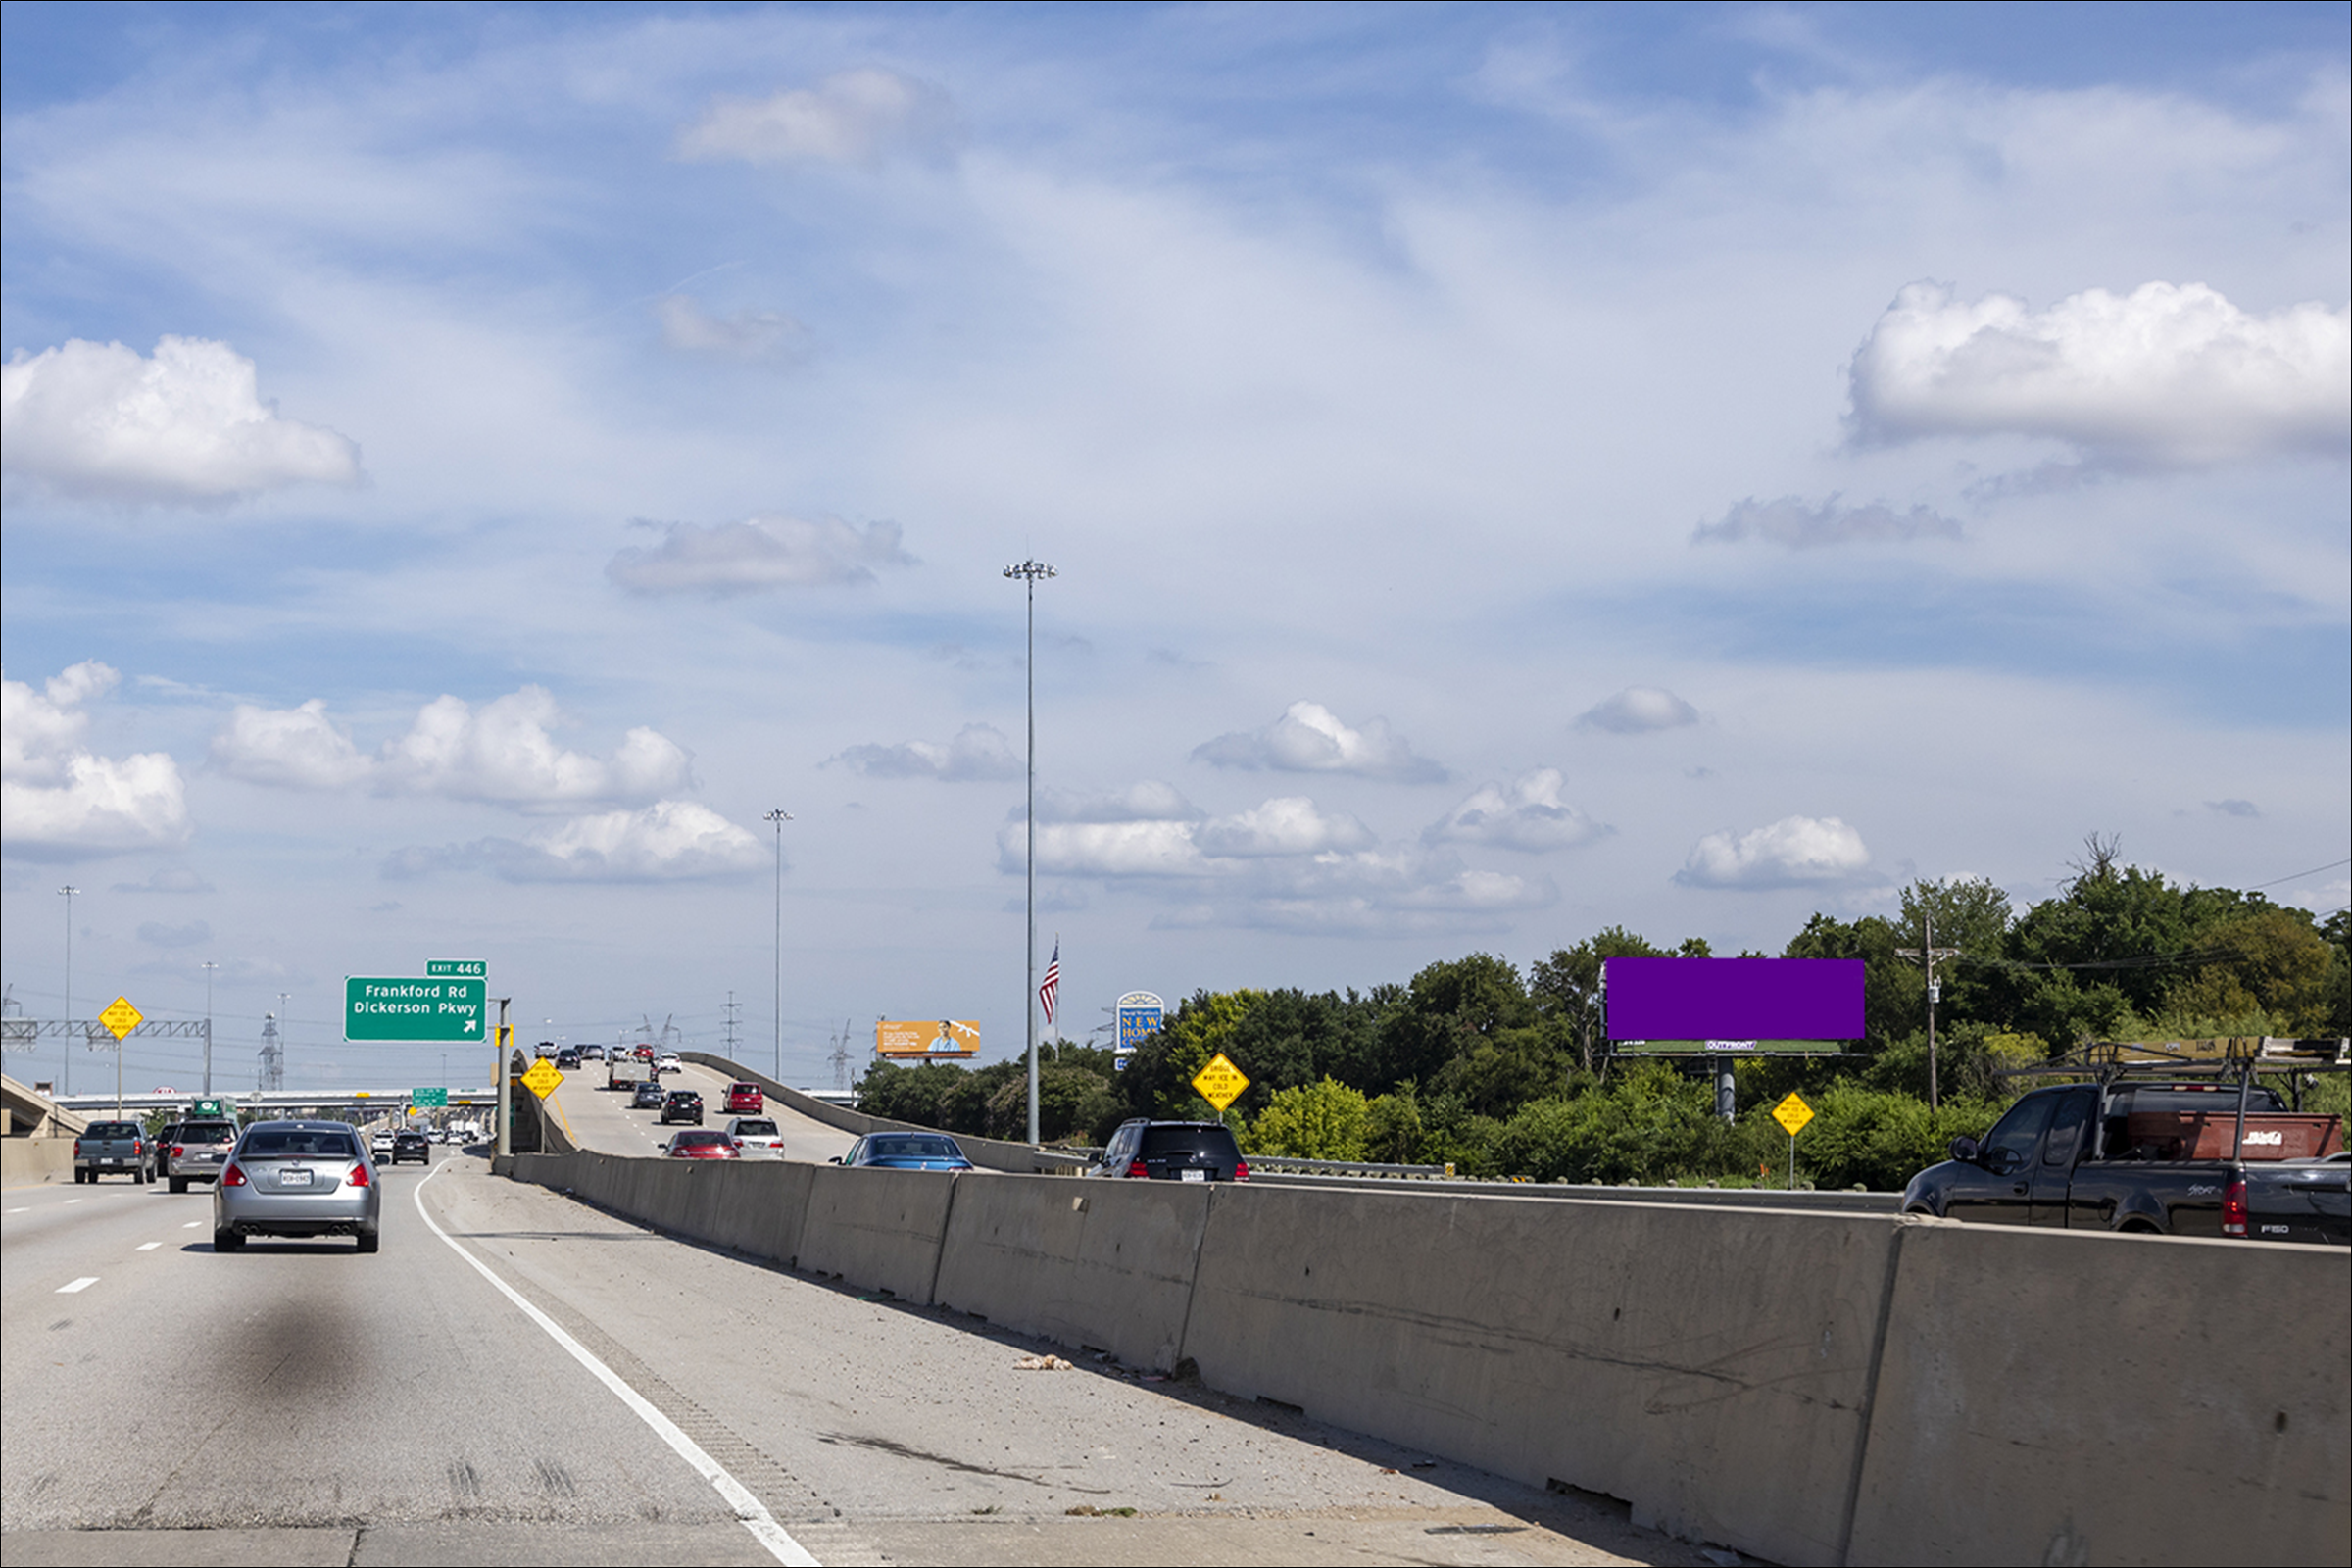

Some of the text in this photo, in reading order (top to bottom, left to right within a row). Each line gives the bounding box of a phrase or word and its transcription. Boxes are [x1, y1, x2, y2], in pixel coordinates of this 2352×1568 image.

[431, 963, 482, 974] EXIT 446
[365, 985, 467, 998] Frankford Rd
[354, 1002, 477, 1017] Dickerson Pkwy
